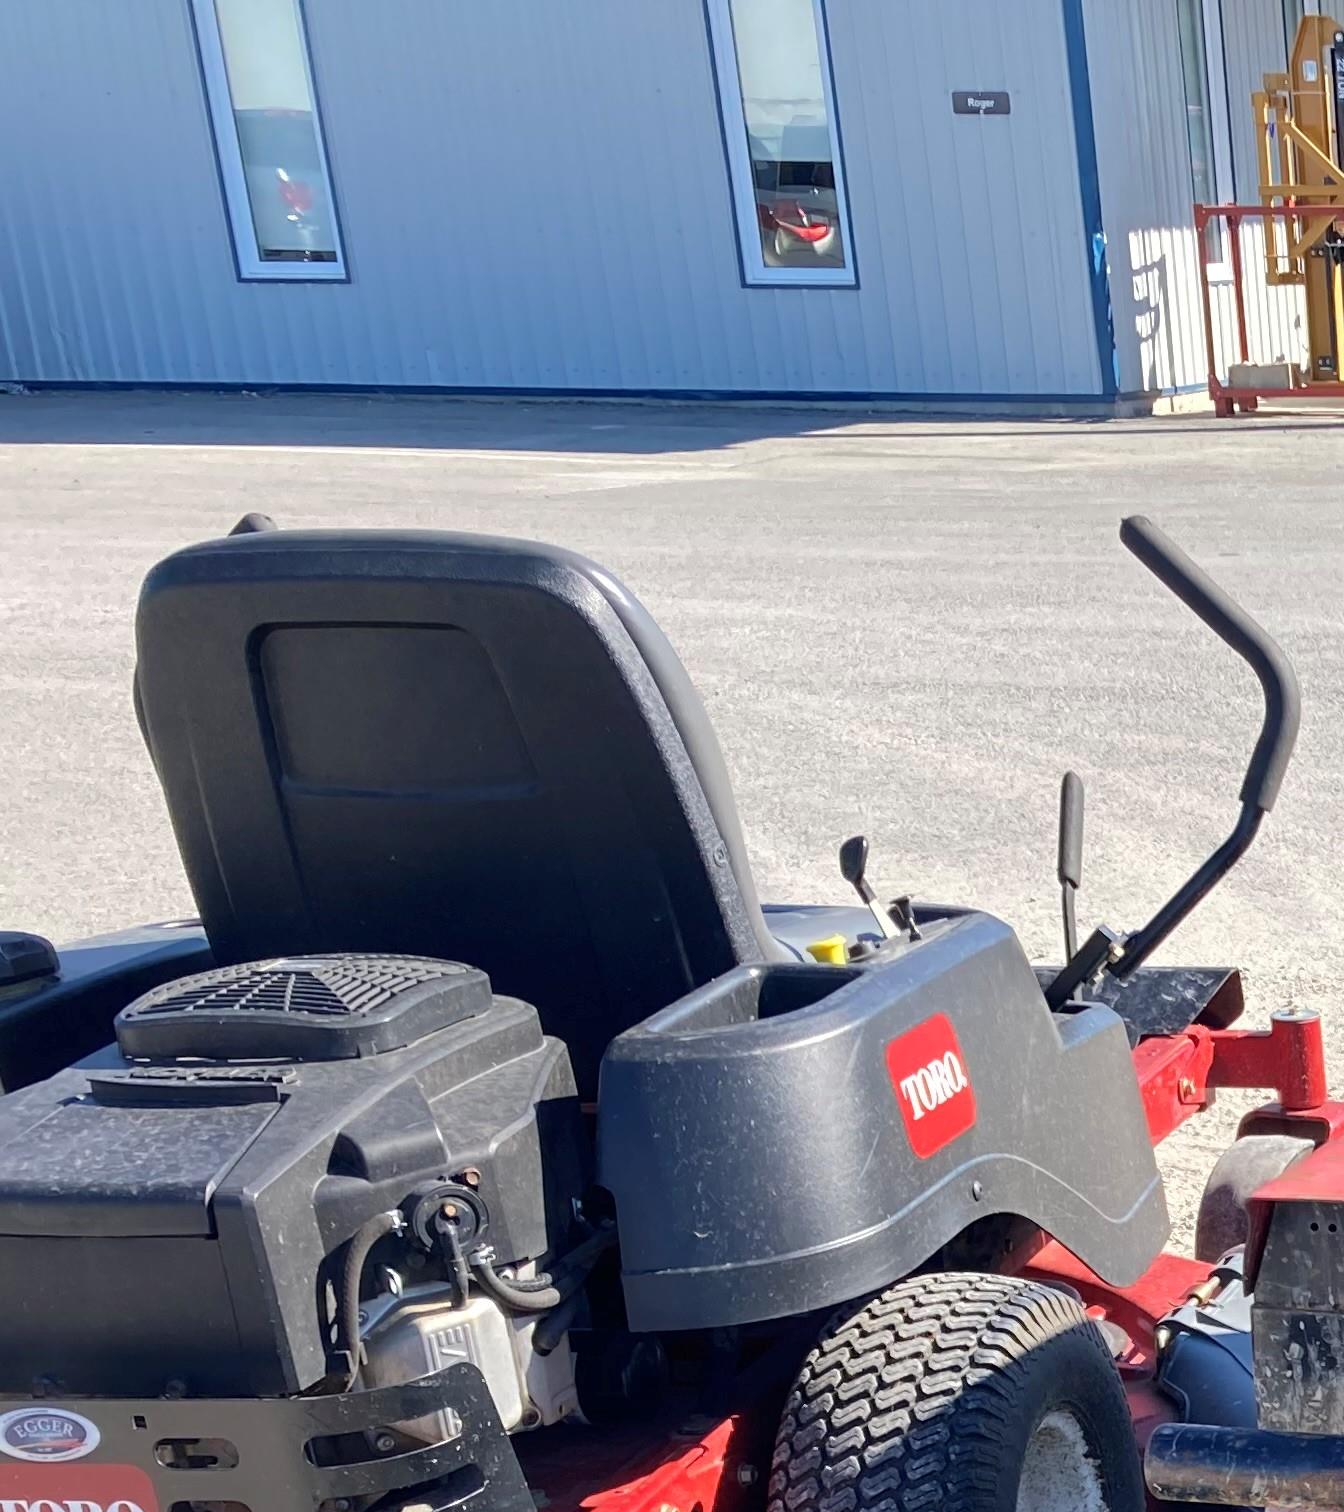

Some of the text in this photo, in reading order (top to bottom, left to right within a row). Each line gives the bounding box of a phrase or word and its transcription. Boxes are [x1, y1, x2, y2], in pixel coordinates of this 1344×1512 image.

[967, 97, 995, 110] Roger
[900, 1051, 968, 1121] TORO
[13, 1419, 74, 1439] EGGER
